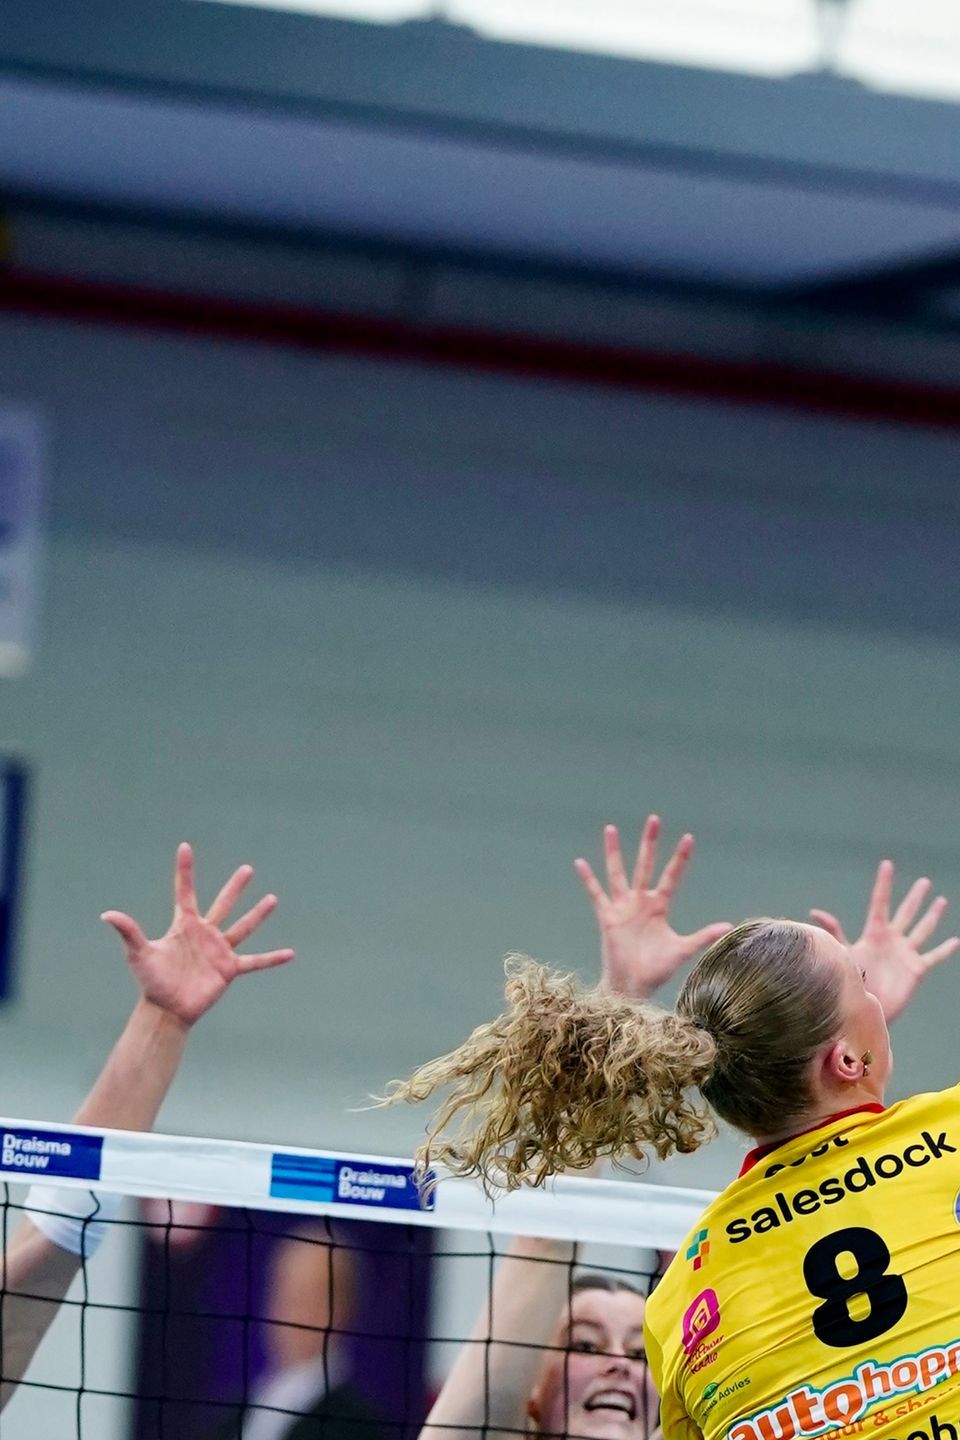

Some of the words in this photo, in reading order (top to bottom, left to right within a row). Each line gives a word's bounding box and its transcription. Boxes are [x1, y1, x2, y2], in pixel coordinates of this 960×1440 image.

[3, 1133, 71, 1156] Draisma
[2, 1149, 50, 1169] Bouw
[338, 1181, 386, 1201] Bouw
[725, 1131, 957, 1244] salesdock
[803, 1226, 908, 1348] 8
[718, 1376, 751, 1400] Advies
[873, 1409, 890, 1428] &
